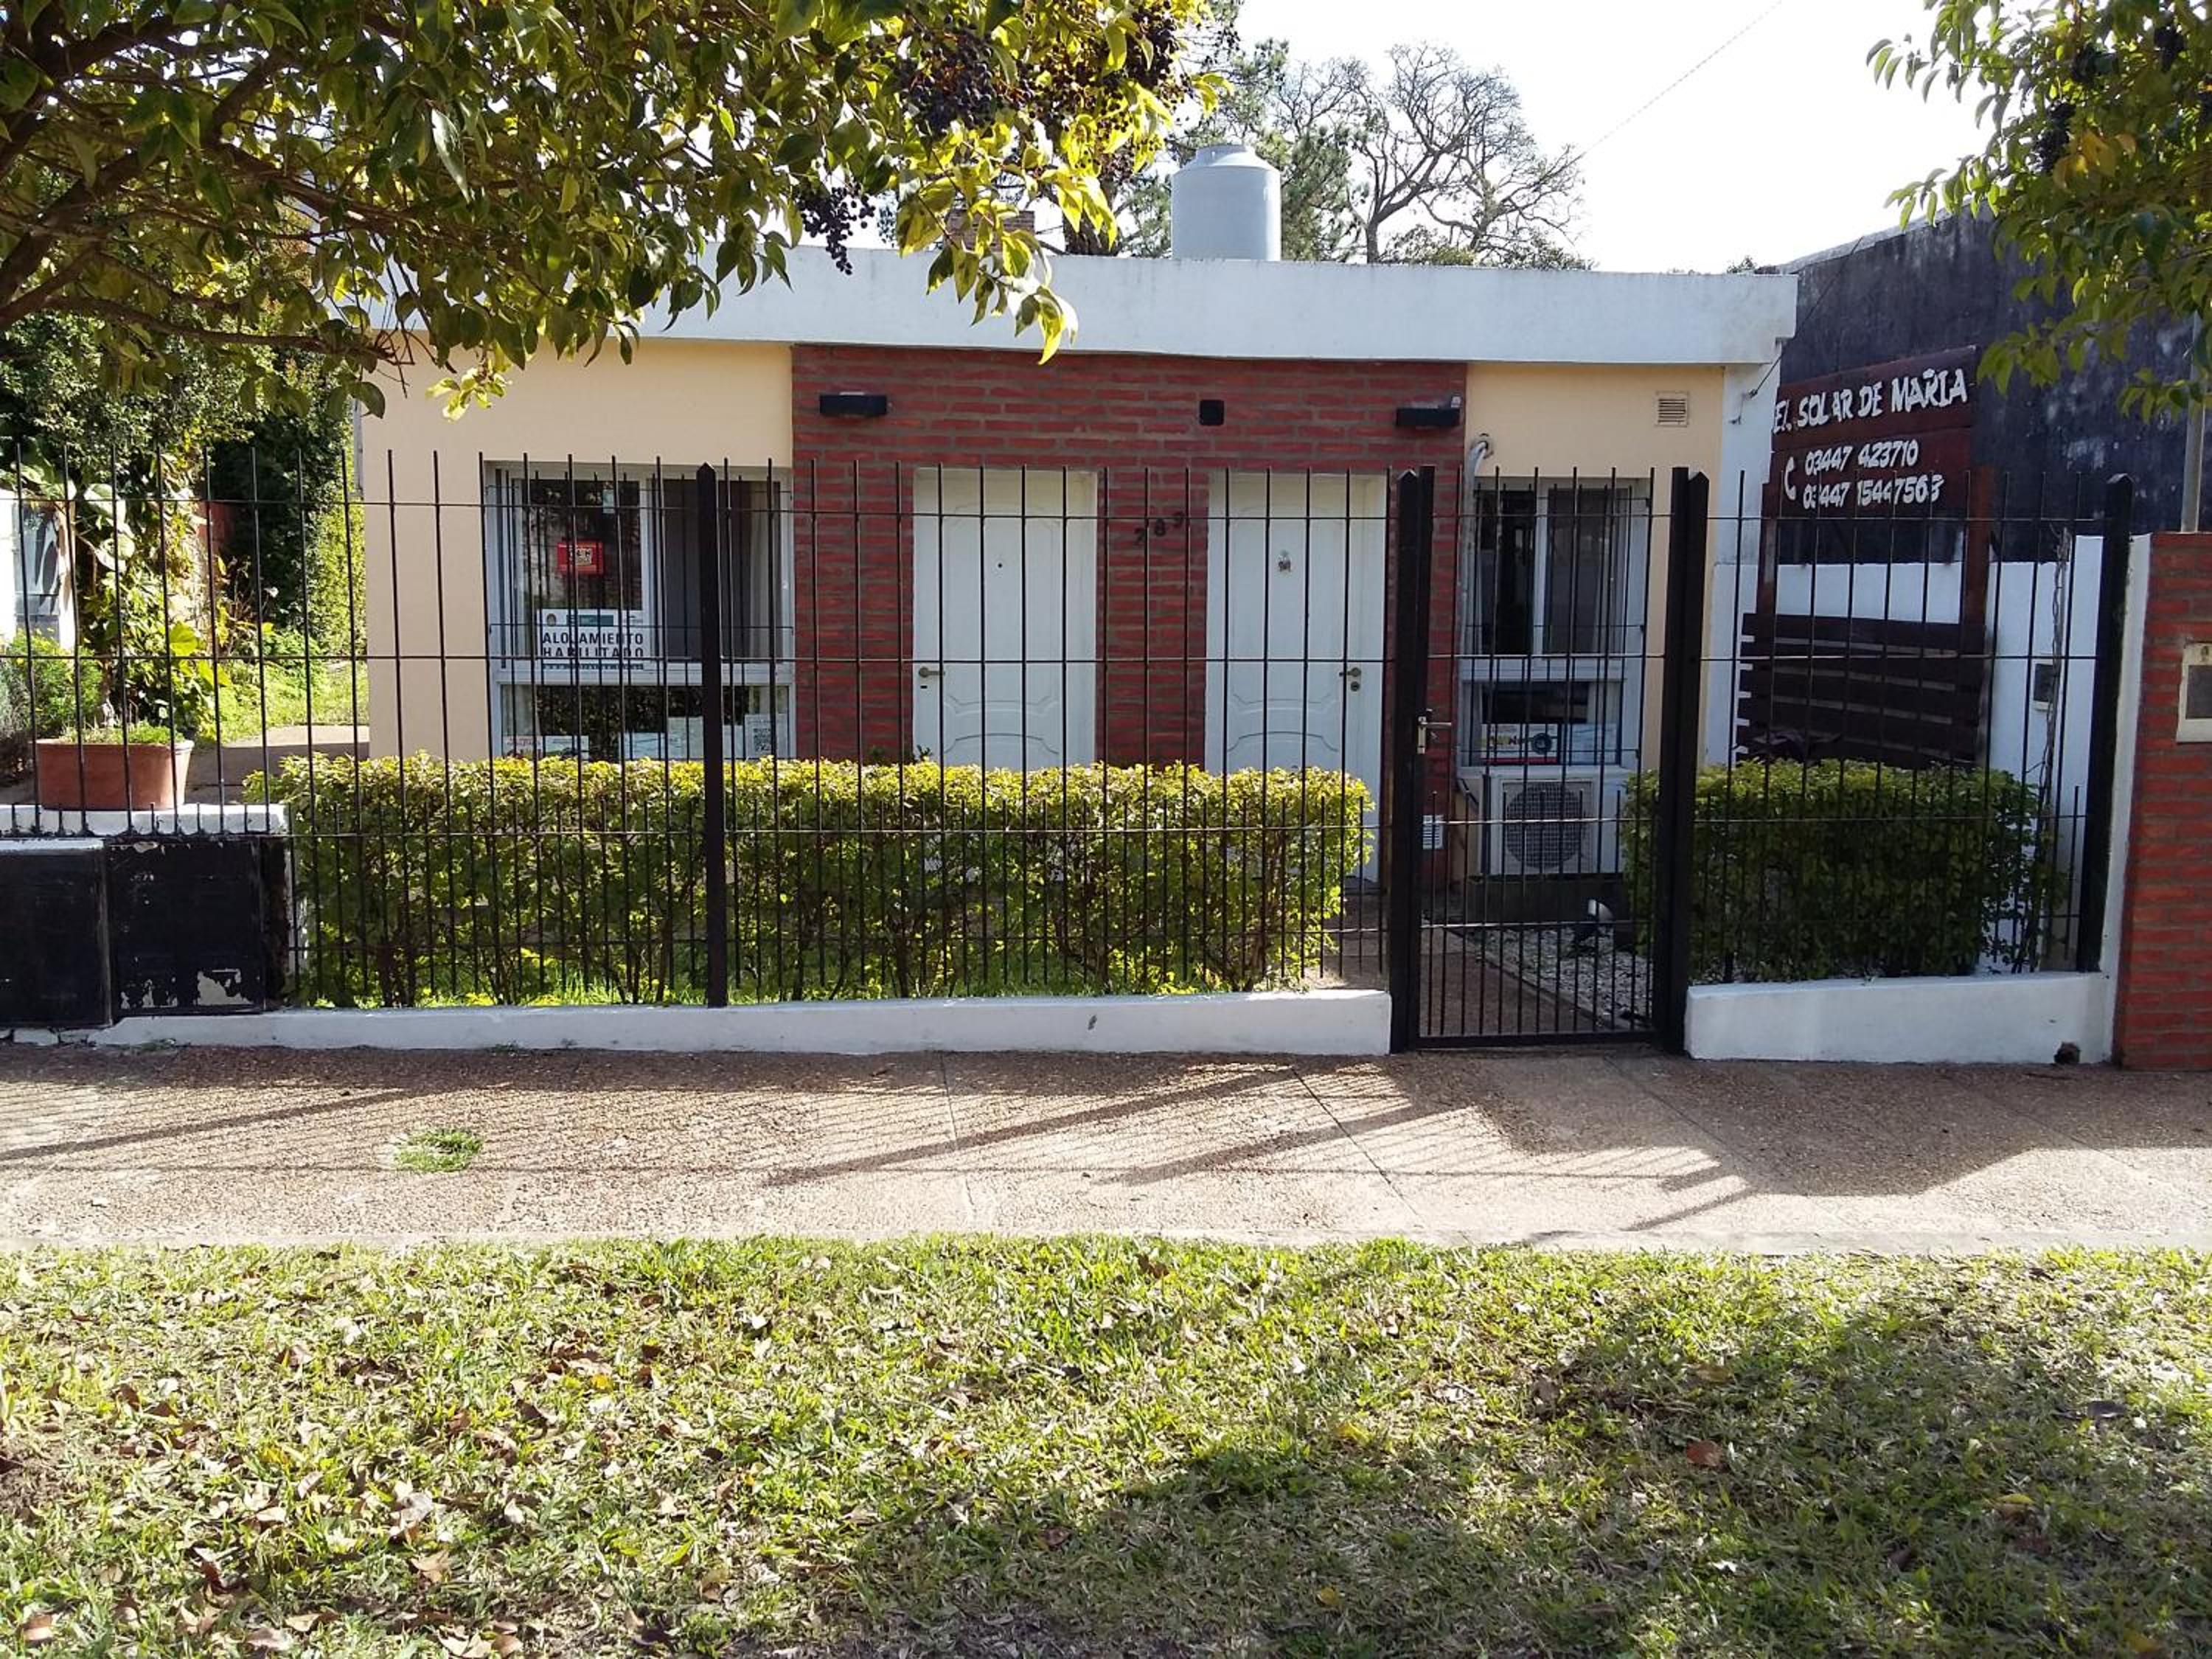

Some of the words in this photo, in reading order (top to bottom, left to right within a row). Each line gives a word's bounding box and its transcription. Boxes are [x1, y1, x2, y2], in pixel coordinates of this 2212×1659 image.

[1797, 389, 1854, 428] SOLAR
[1857, 381, 1882, 417] DE
[1805, 446, 1853, 476] 03447
[1857, 439, 1919, 468] 423710
